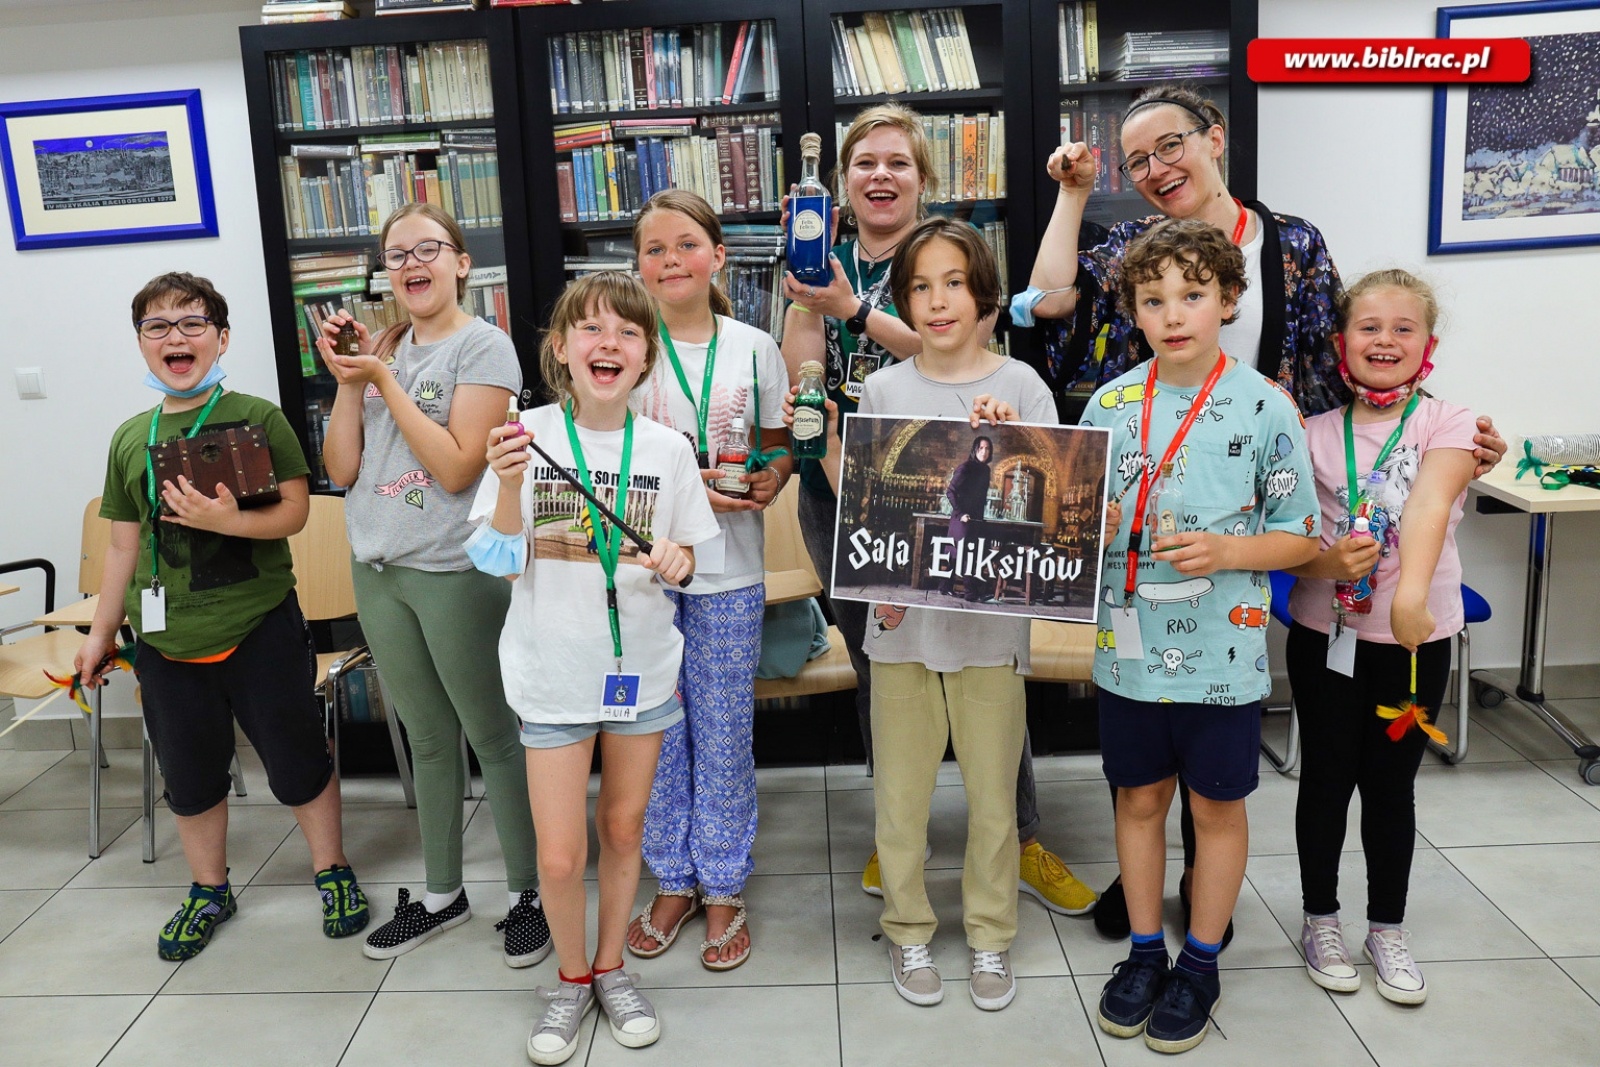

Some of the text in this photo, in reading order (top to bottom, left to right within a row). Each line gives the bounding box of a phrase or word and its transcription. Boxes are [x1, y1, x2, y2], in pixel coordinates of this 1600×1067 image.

[55, 201, 100, 209] MUZYKALIA
[1231, 433, 1253, 445] JUST
[391, 472, 420, 495] FOREVER
[533, 466, 539, 480] I
[594, 470, 609, 485] SO
[632, 474, 661, 491] MINE
[1268, 476, 1293, 496] YEAH!
[848, 526, 1084, 583] Sala Eliksirów
[1167, 618, 1198, 635] RAD
[1205, 683, 1231, 695] JUST
[1202, 696, 1236, 706] ENJOY
